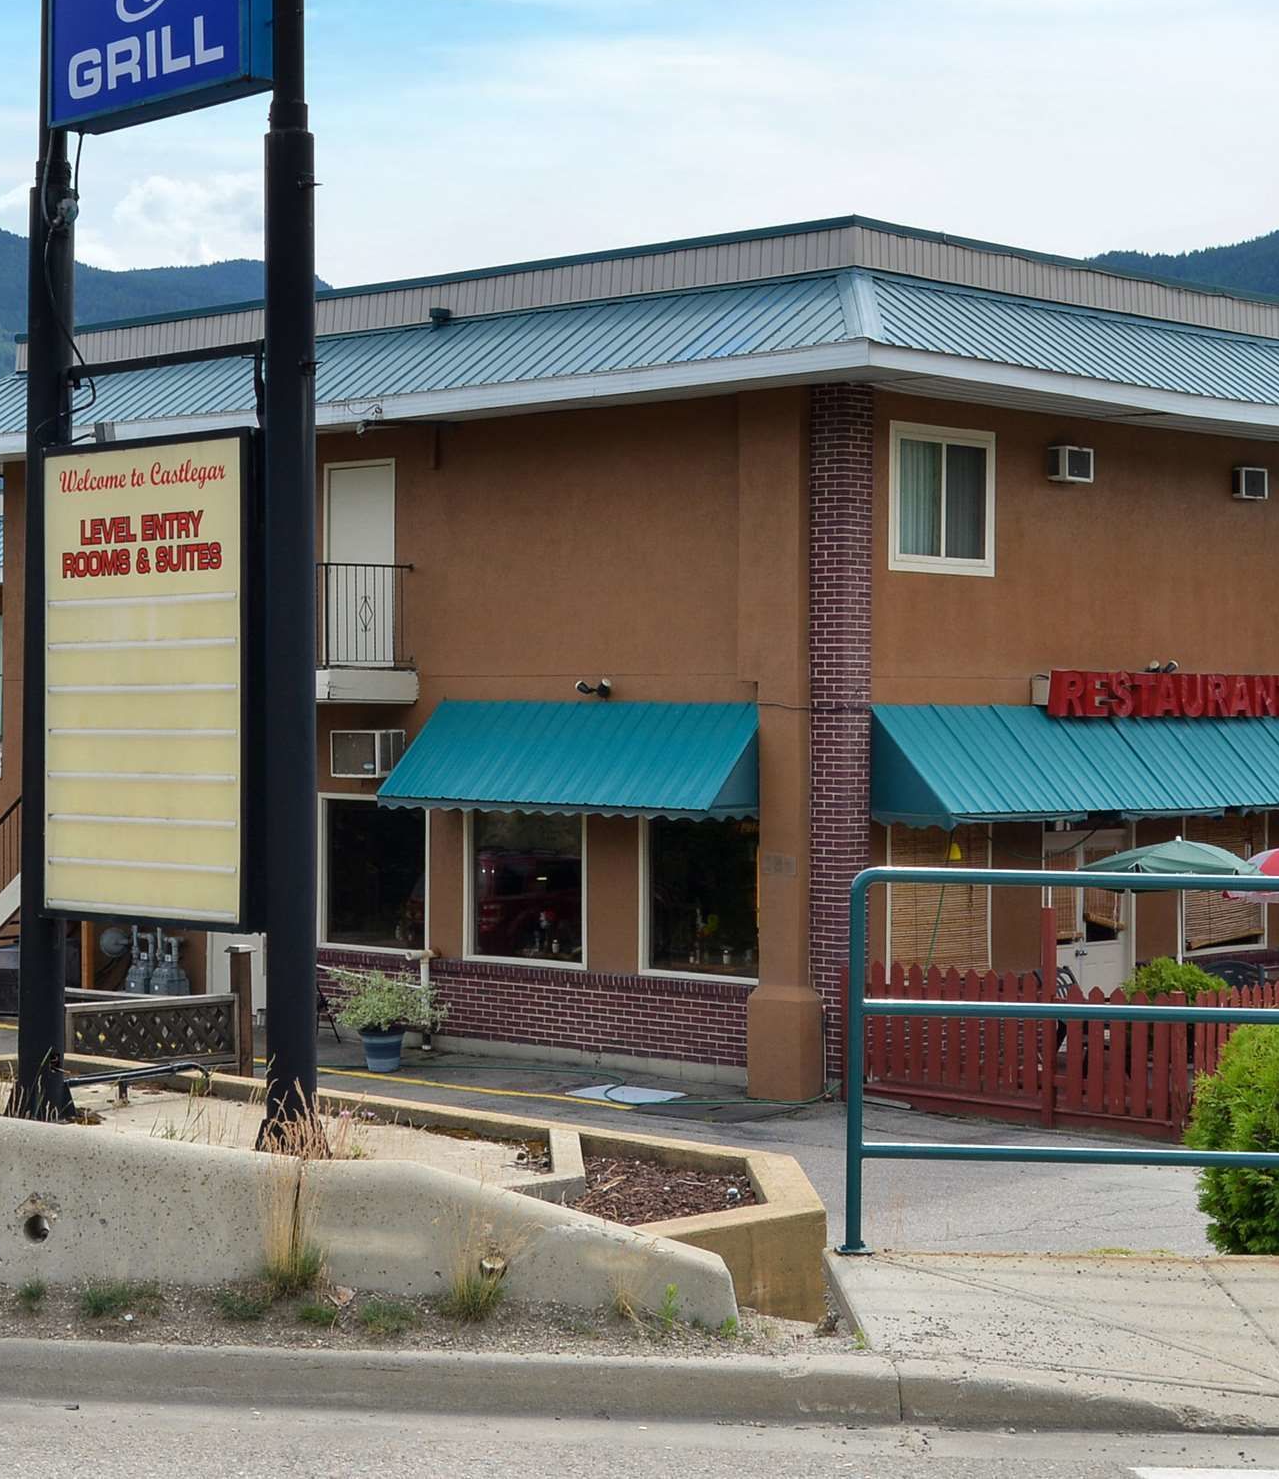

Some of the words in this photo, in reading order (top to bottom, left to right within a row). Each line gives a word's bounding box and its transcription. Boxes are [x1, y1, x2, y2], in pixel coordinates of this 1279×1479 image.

[68, 15, 224, 100] GRILL
[59, 468, 126, 493] Welcome
[131, 468, 145, 487] to
[150, 458, 226, 490] Castlegar
[80, 516, 137, 546] LEVEL
[141, 510, 204, 542] ENTRY
[62, 548, 130, 579] ROOMS
[136, 548, 151, 575] &
[155, 542, 222, 573] SUITES
